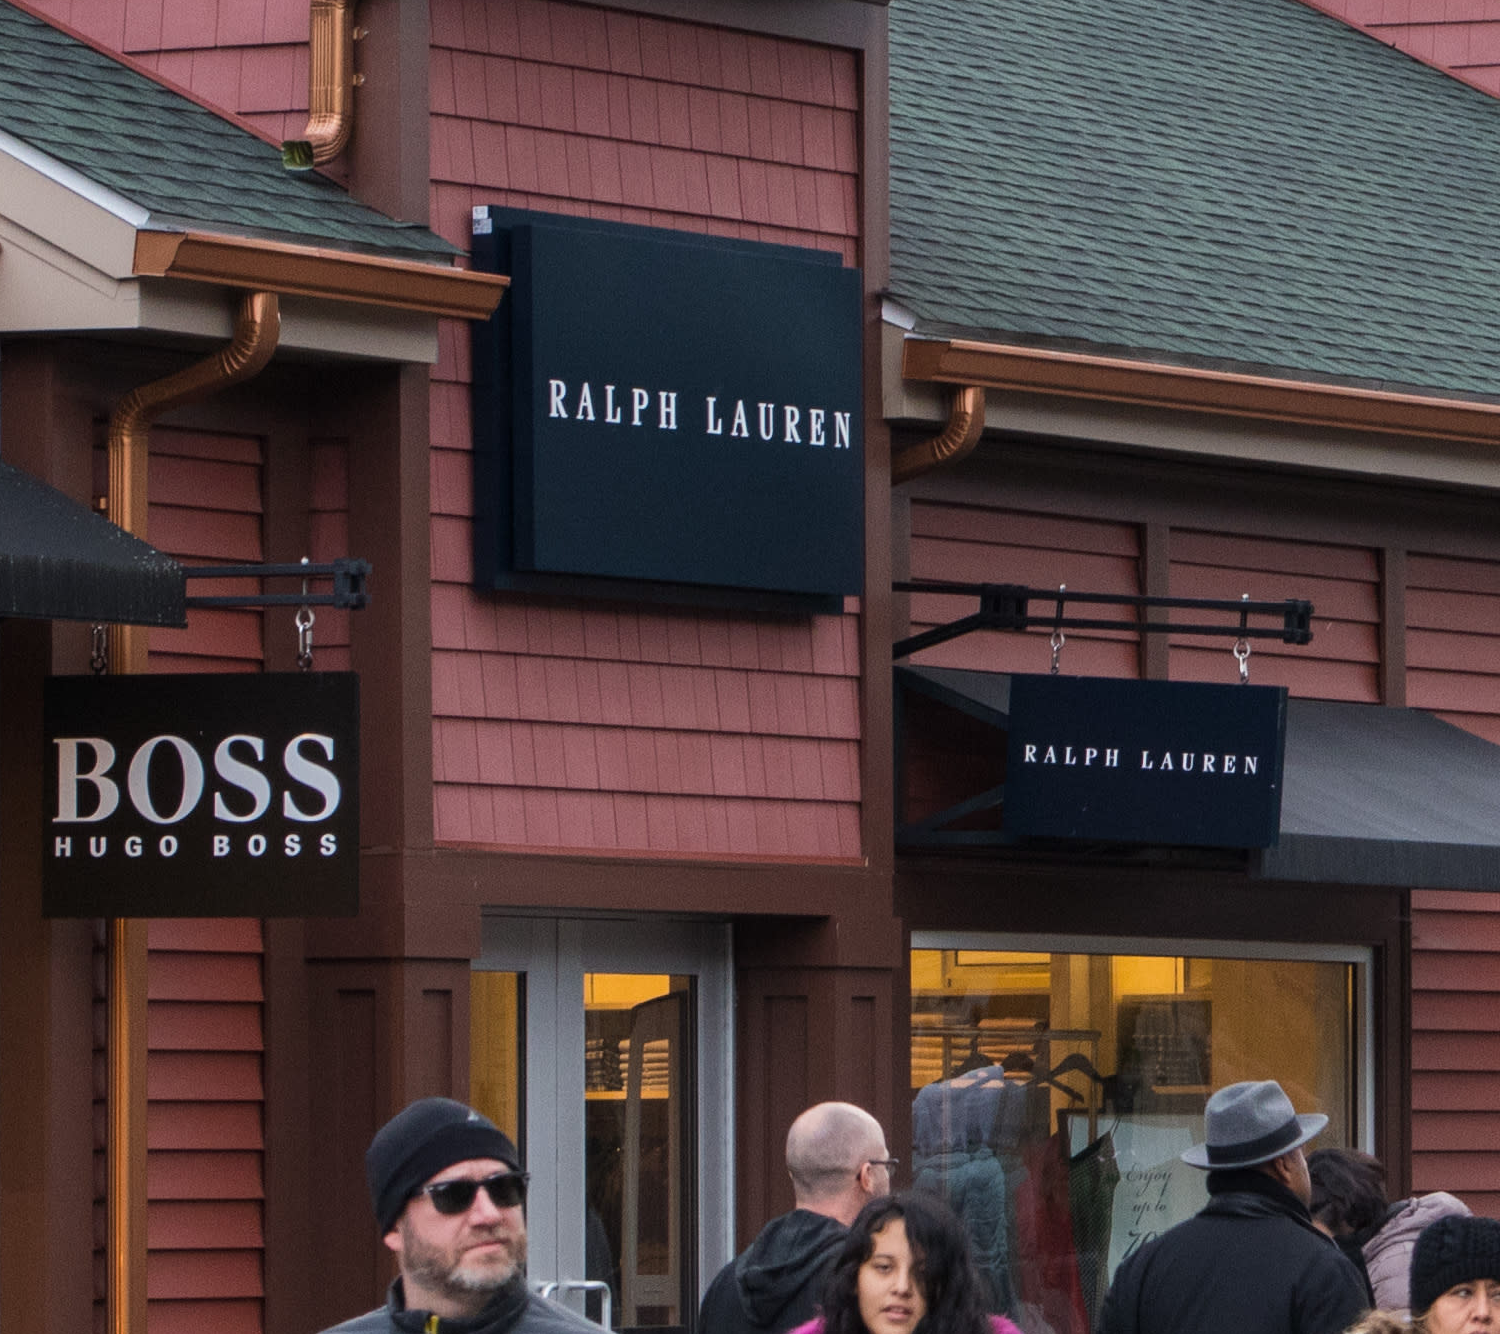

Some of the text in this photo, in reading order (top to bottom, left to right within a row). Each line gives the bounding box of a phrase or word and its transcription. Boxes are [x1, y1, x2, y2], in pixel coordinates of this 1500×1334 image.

[549, 379, 851, 450] RALPH LAUREN
[52, 733, 341, 824] BOSS
[1024, 744, 1258, 774] RALPH LAUREN
[54, 833, 338, 858] HUGO BOSS
[1126, 1163, 1173, 1205] Enjoy
